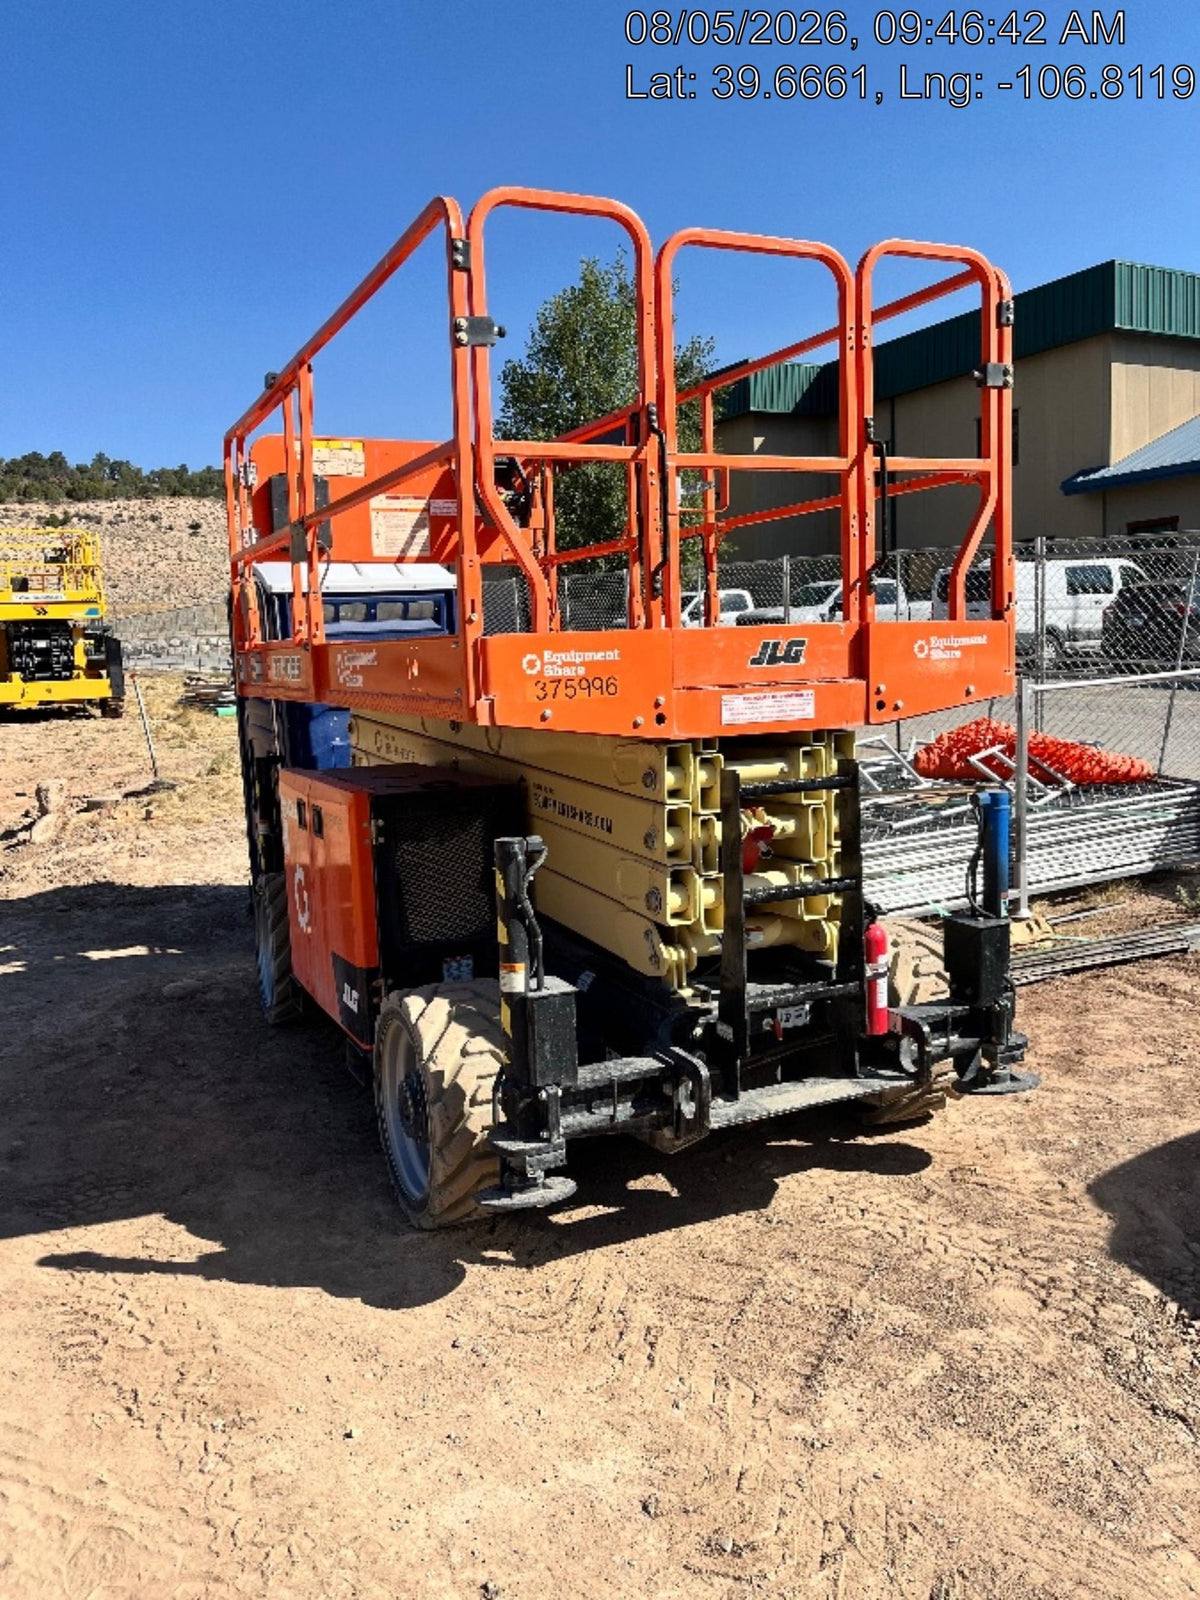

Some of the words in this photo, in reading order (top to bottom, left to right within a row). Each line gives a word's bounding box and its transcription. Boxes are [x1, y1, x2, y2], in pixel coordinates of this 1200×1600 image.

[543, 649, 620, 665] Equipment
[748, 638, 808, 667] JLG
[543, 664, 586, 677] Share
[534, 675, 618, 701] 375996
